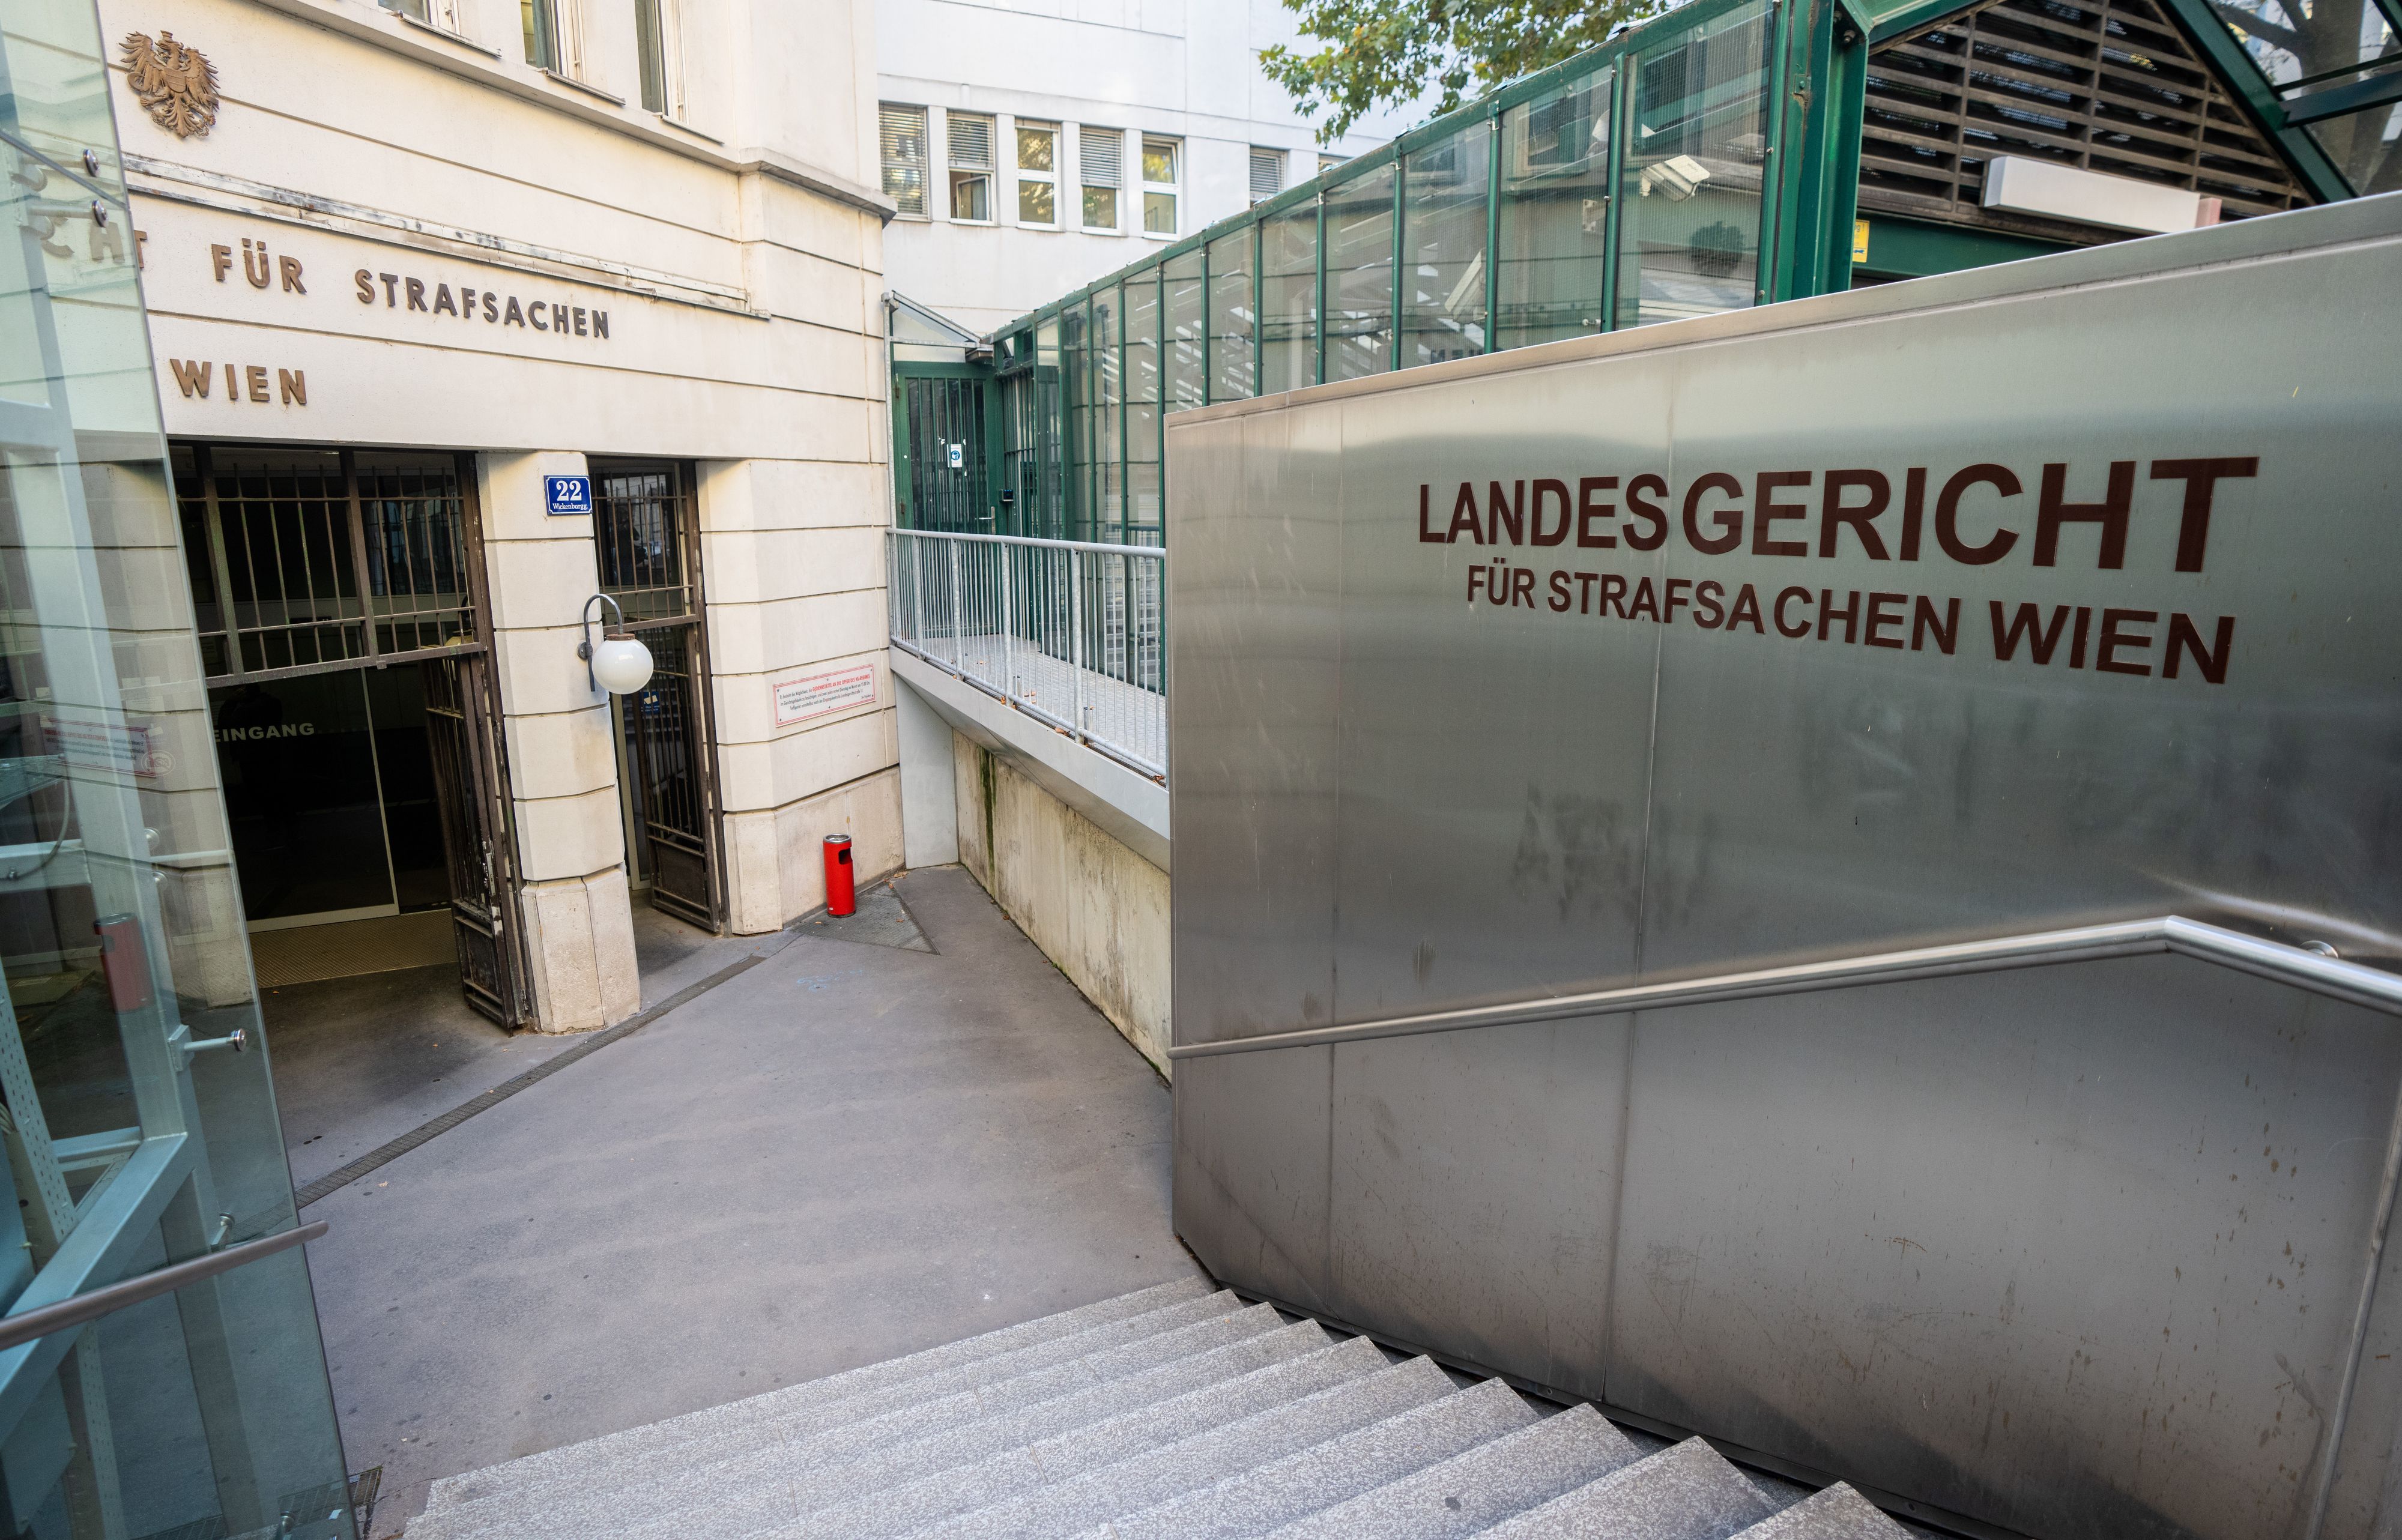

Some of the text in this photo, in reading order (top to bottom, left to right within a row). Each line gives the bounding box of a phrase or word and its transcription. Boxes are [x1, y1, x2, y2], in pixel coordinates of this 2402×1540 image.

[211, 238, 307, 294] FÜR
[355, 269, 609, 339] STRAFSACHEN
[170, 358, 307, 405] WIEN
[556, 480, 582, 501] 22
[1420, 456, 2259, 573] LANDESGERICHT
[1468, 557, 2236, 684] FÜR STRAFSACHEN WIEN
